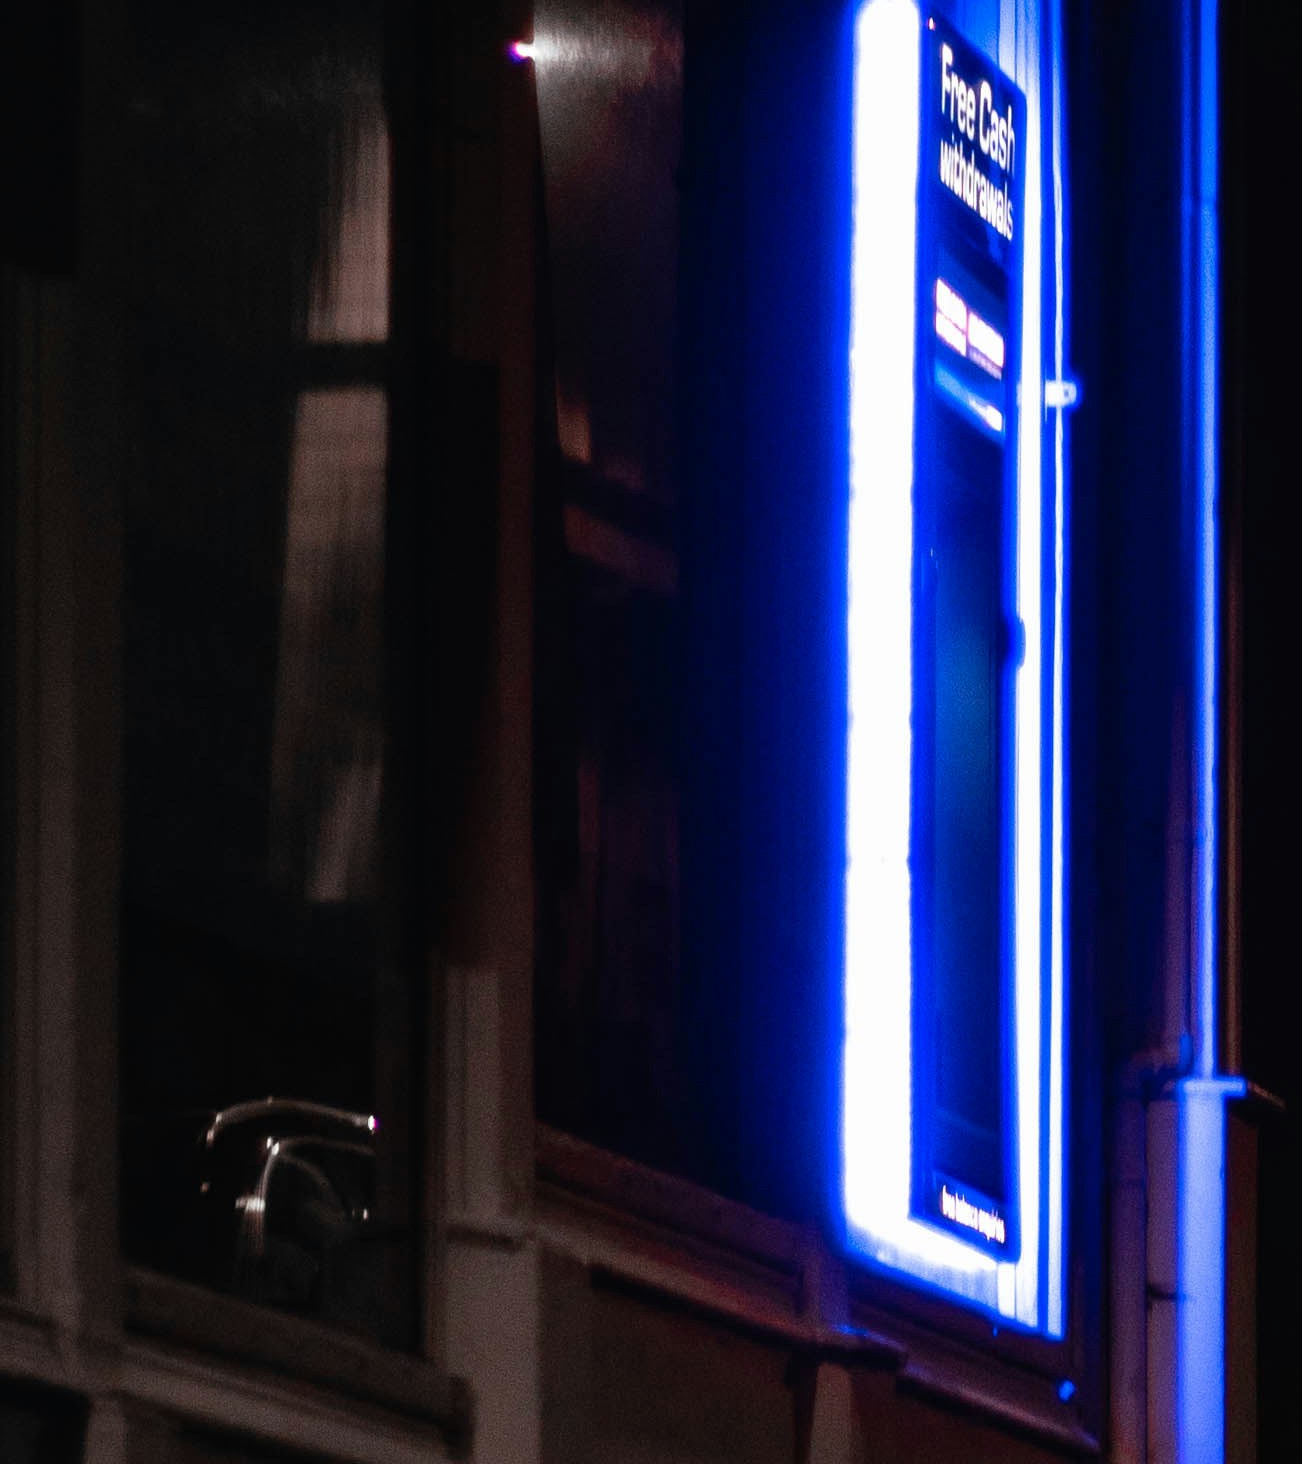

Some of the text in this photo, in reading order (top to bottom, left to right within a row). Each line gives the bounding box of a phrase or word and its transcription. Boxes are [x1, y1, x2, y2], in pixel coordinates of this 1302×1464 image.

[940, 42, 1016, 180] Free Cash
[940, 134, 1014, 242] withdrawals
